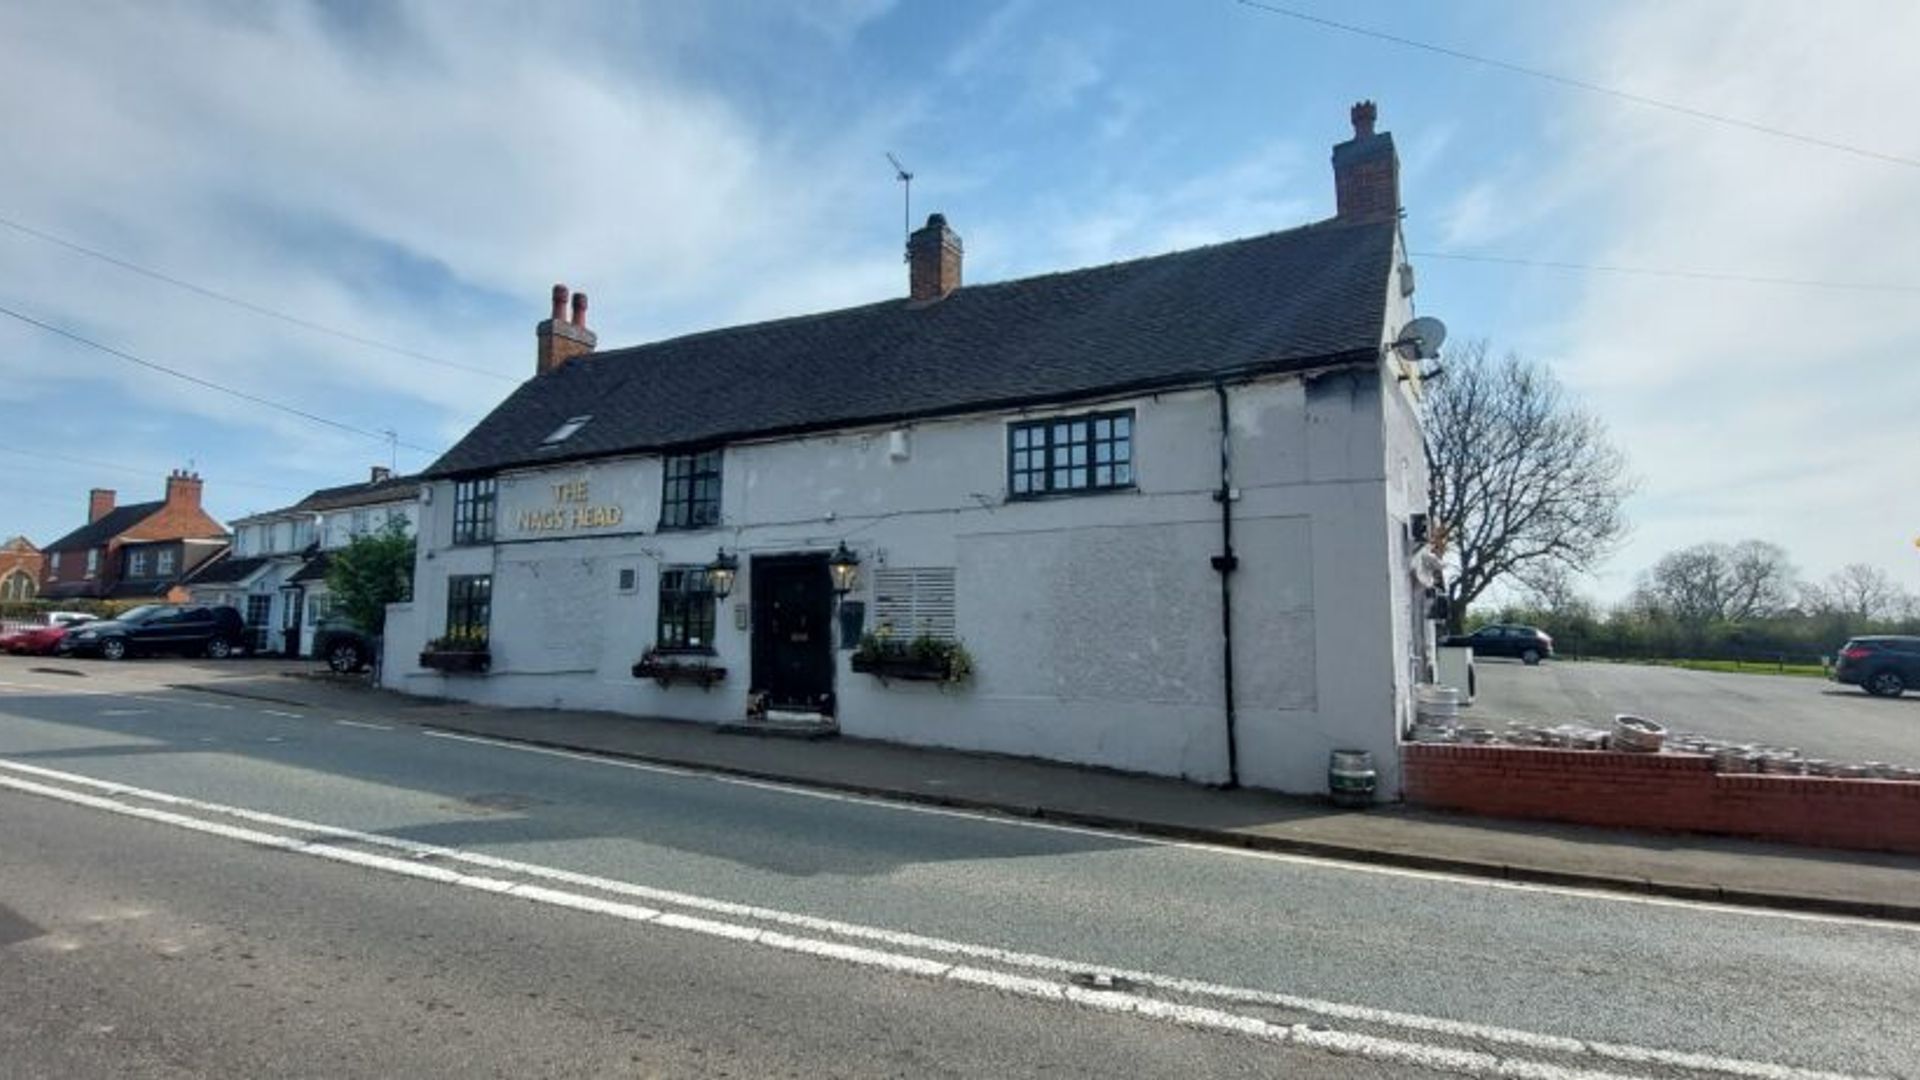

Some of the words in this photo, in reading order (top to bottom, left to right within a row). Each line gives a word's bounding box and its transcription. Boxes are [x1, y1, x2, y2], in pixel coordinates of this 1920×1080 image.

[550, 480, 589, 503] THE
[515, 506, 565, 531] NAGS
[571, 504, 623, 529] HEAD
